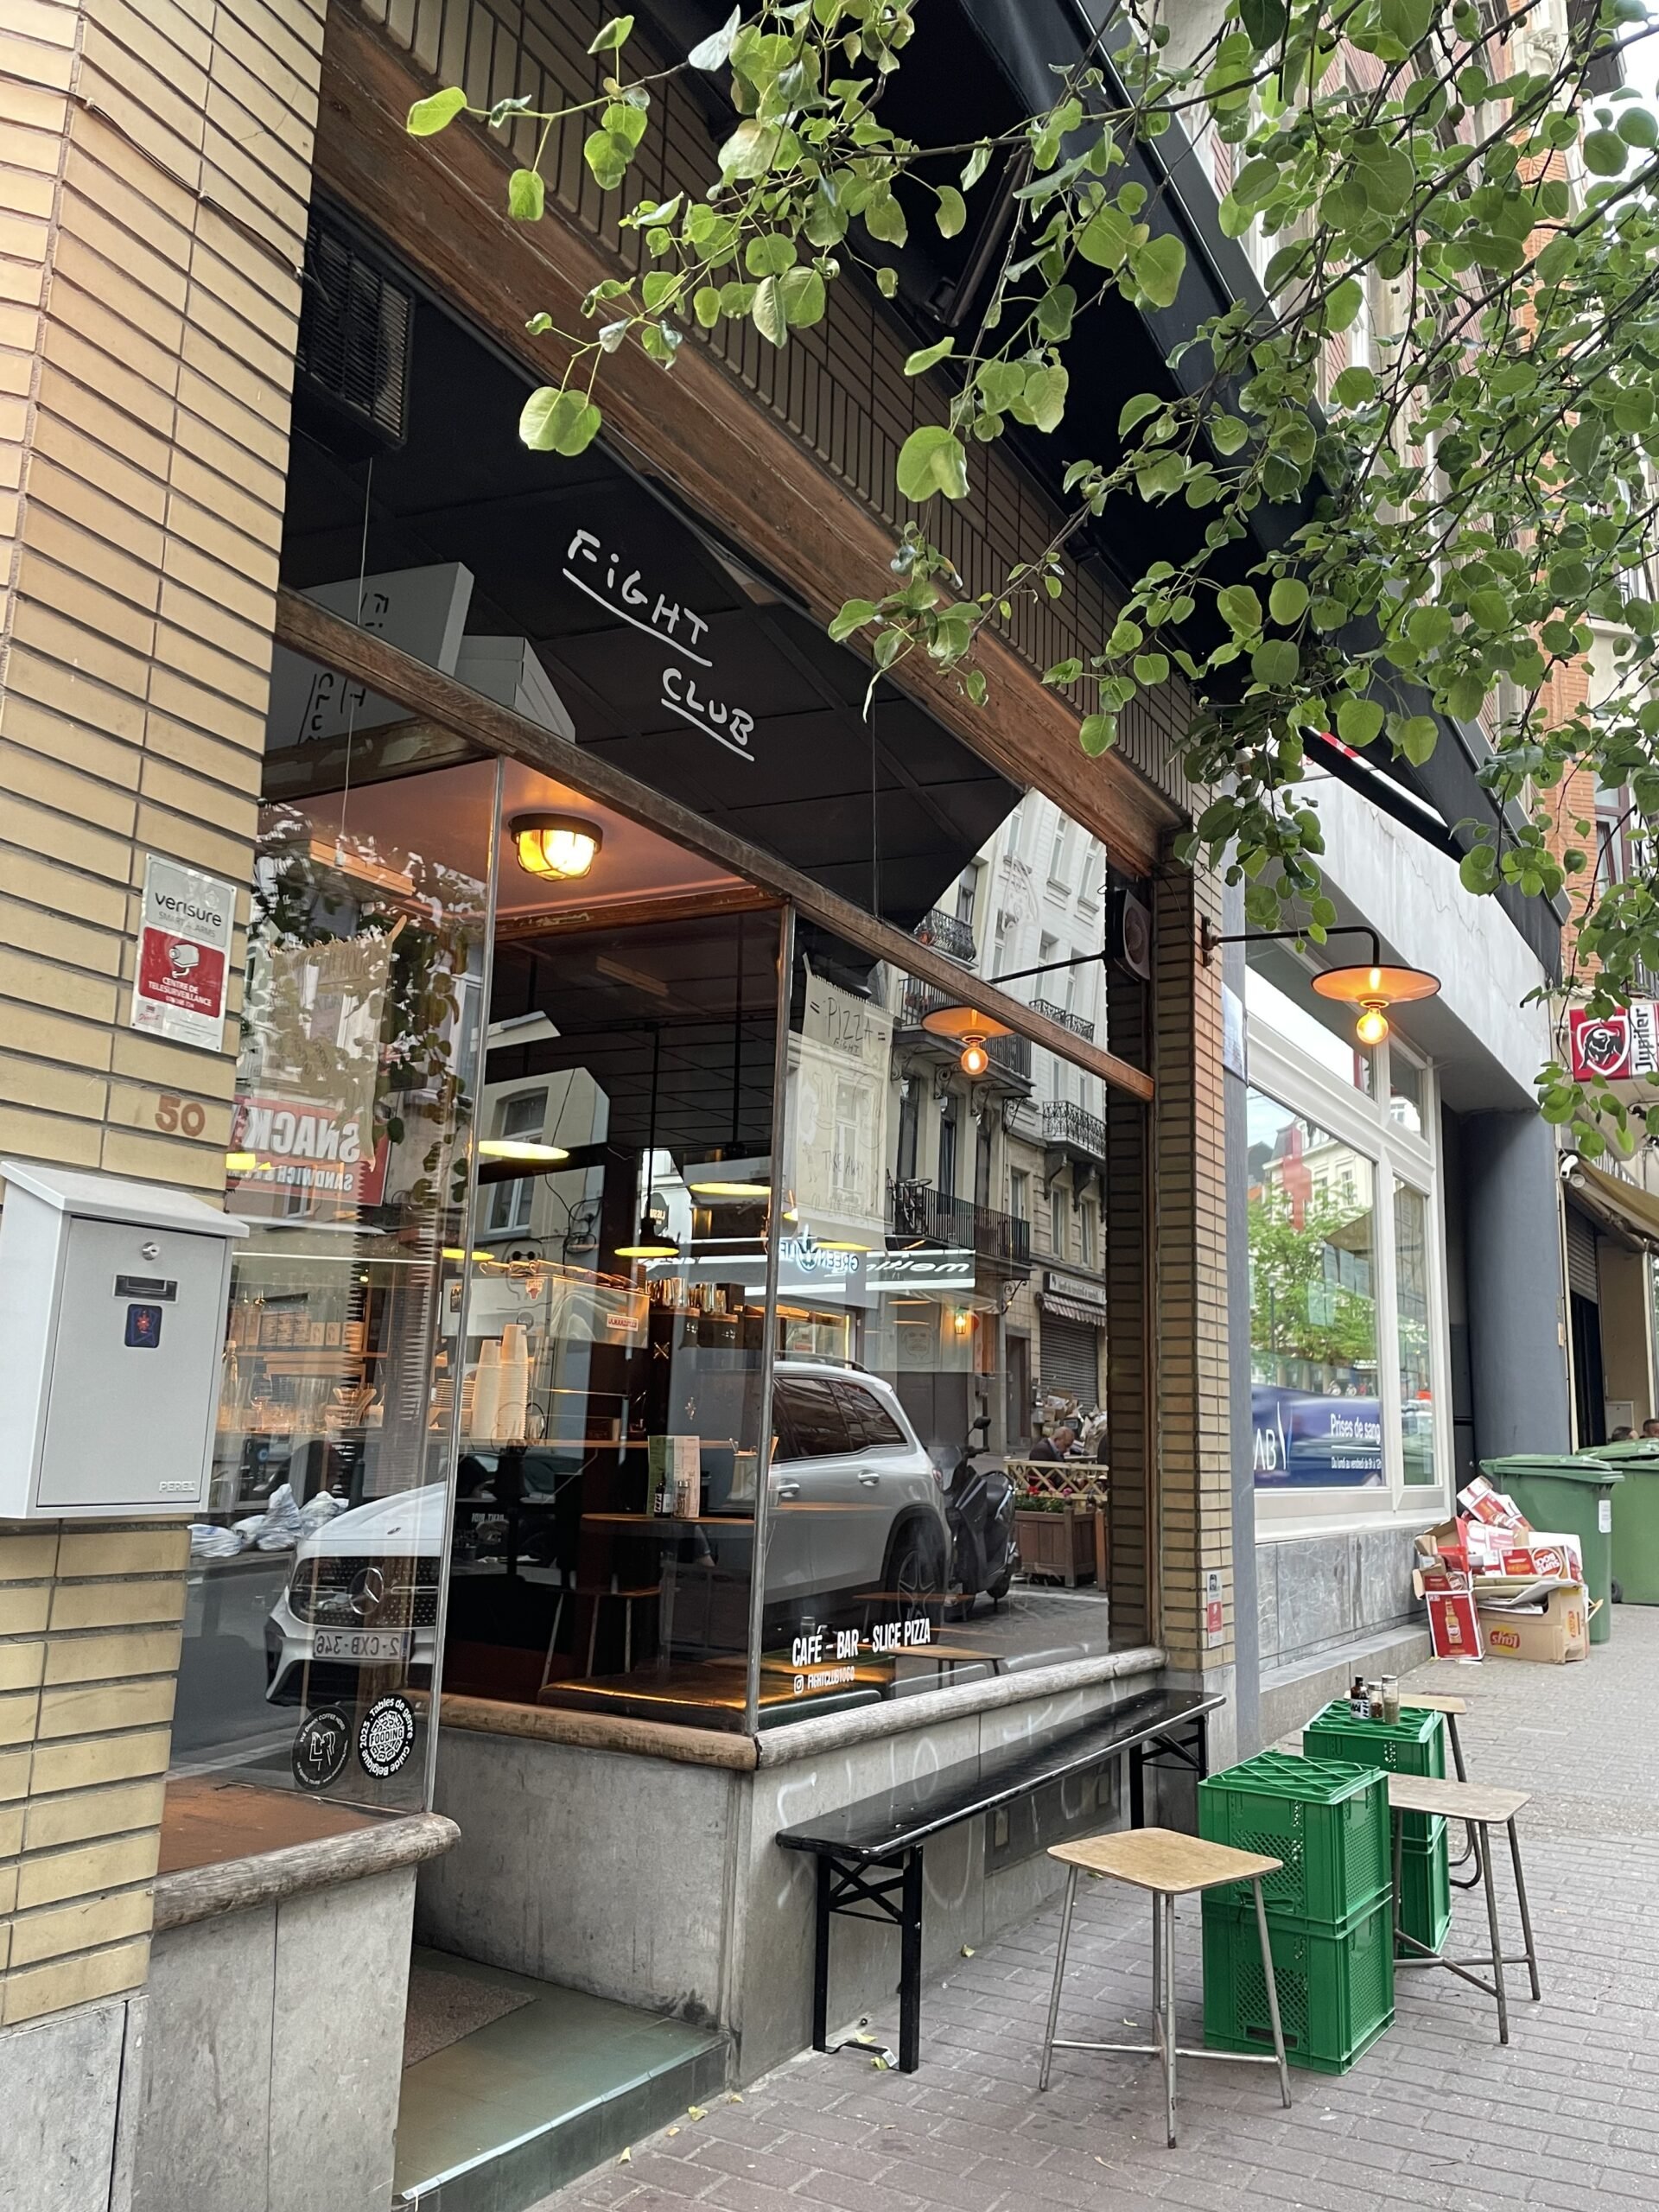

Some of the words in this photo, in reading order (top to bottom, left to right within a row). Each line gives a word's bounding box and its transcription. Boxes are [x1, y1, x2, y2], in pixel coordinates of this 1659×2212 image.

[661, 667, 755, 745] CLUB
[155, 893, 222, 927] verisure
[187, 921, 216, 938] AARMS
[149, 980, 213, 1007] TELESURVEILLANCE
[162, 976, 189, 992] CENTRE
[189, 984, 199, 995] DE
[1634, 1007, 1654, 1072] Jupiler
[155, 1094, 206, 1138] 50
[1331, 1413, 1353, 1438] Prises
[1354, 1417, 1363, 1439] de
[1364, 1421, 1381, 1445] sang
[158, 1480, 196, 1493] PEREL
[791, 1626, 823, 1668] CAFÉ
[836, 1629, 860, 1660] BAR
[872, 1622, 902, 1653] SLICE
[904, 1618, 931, 1647] PIZZA
[369, 1698, 395, 1717] Tables
[395, 1699, 405, 1711] de
[402, 1707, 414, 1739] genre
[359, 1720, 371, 1749] 2023
[370, 1727, 404, 1745] FOODING
[361, 1748, 389, 1777] Belgique
